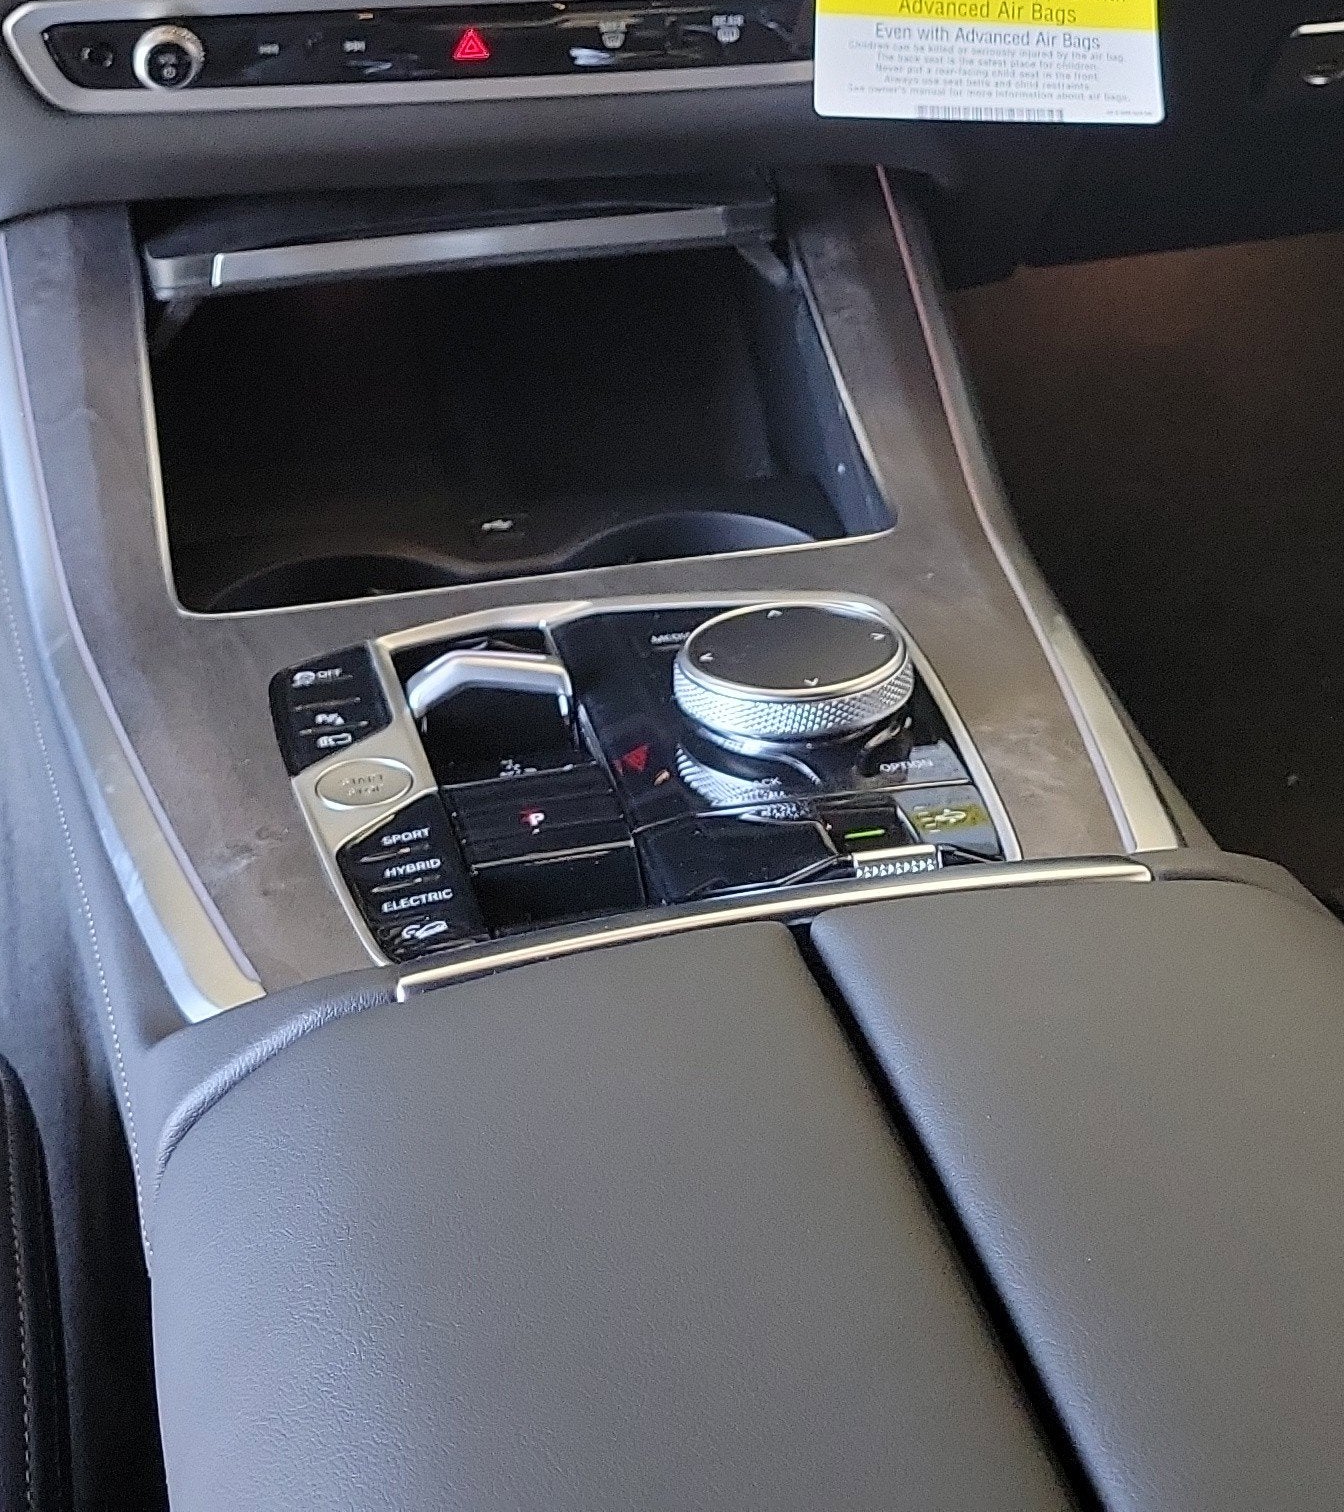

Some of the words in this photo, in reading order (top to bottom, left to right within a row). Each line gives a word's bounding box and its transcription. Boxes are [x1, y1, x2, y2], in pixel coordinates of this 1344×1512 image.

[998, 1, 1024, 19] Air
[1032, 2, 1077, 25] Bags
[875, 22, 911, 40] Even
[917, 26, 949, 42] with
[955, 27, 1030, 46] Advanced
[1036, 32, 1057, 47] Air
[1063, 33, 1101, 50] Bags
[880, 759, 934, 773] OPTION
[530, 813, 545, 826] P
[381, 827, 430, 846] SPORT
[383, 858, 441, 878] HYBRID
[381, 888, 453, 913] ELECTRIC
